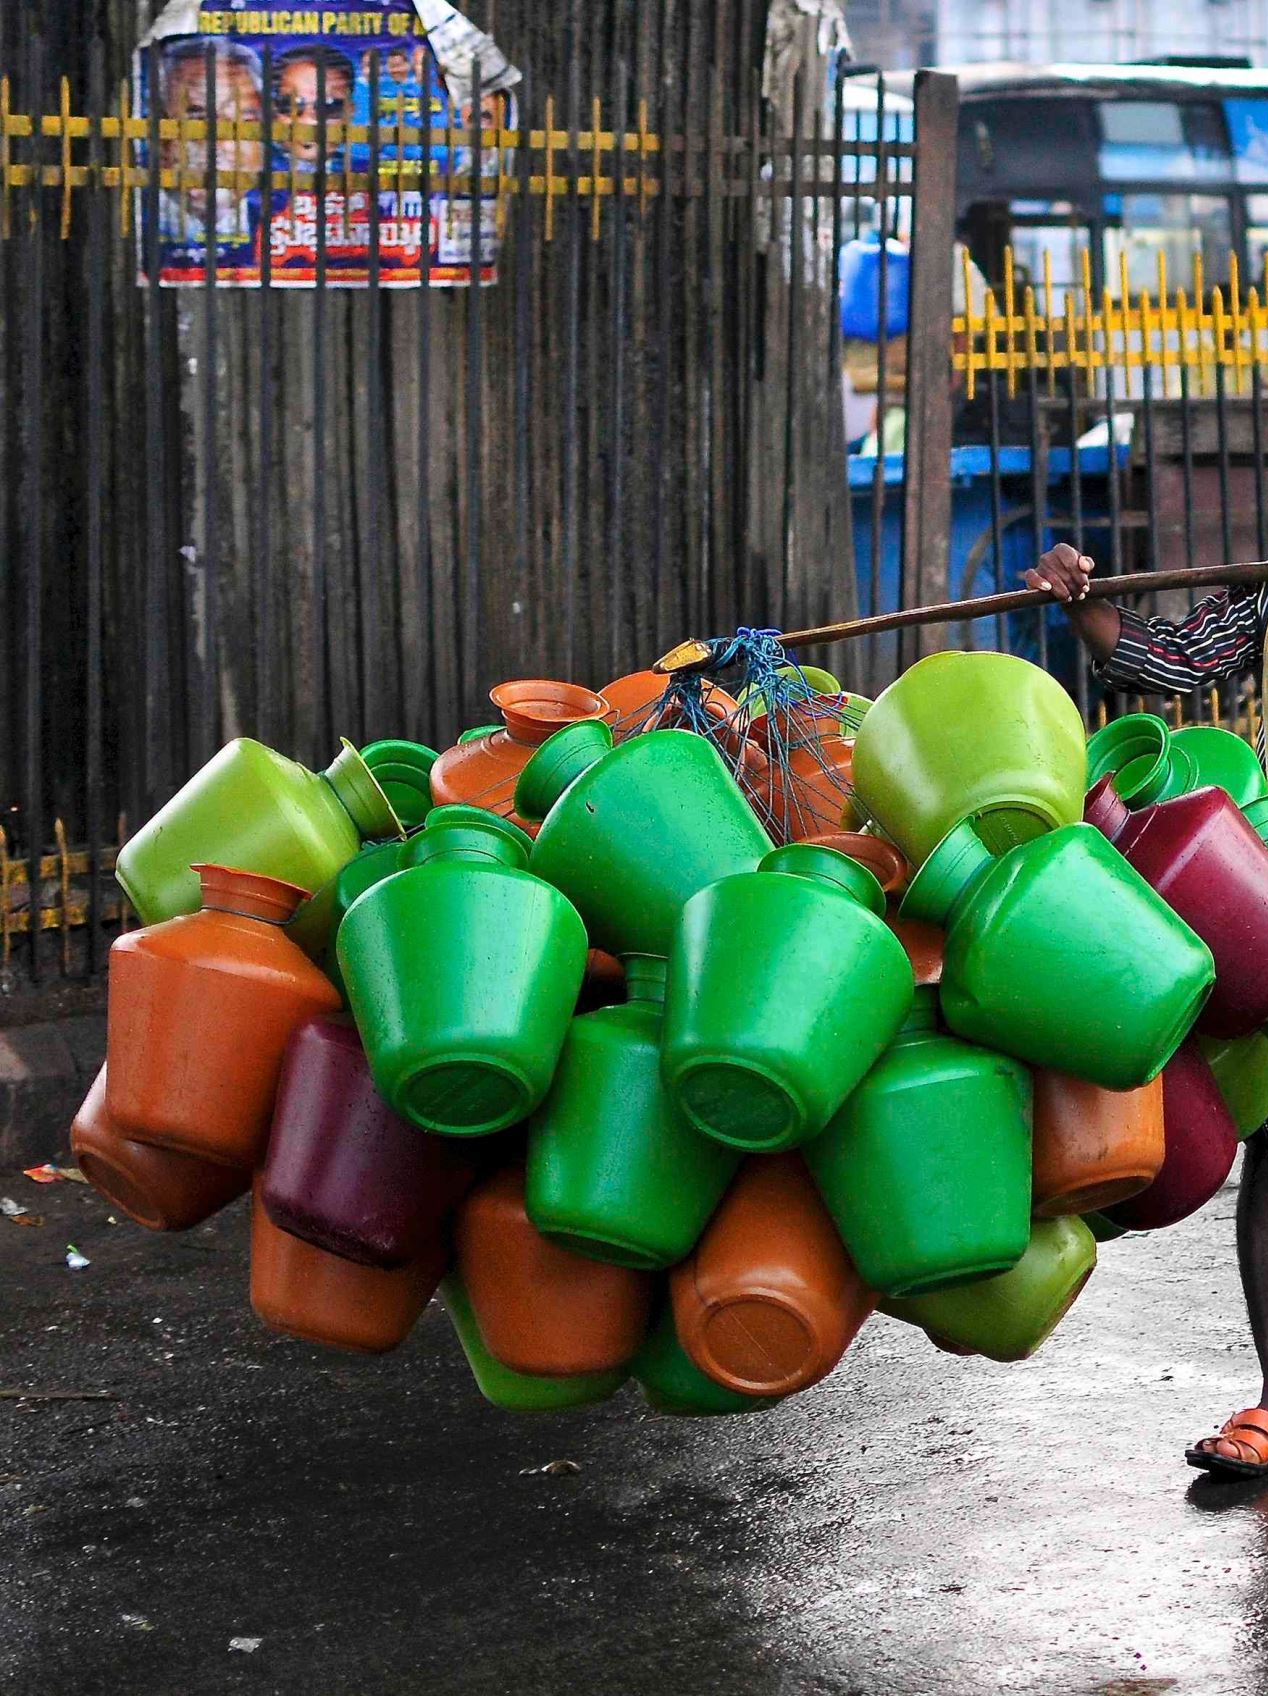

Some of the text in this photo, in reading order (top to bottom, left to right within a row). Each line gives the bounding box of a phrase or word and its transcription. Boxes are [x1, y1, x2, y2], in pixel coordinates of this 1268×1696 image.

[199, 11, 319, 34] REPUBLICAN
[322, 12, 384, 35] PARTY
[388, 13, 409, 36] OF
